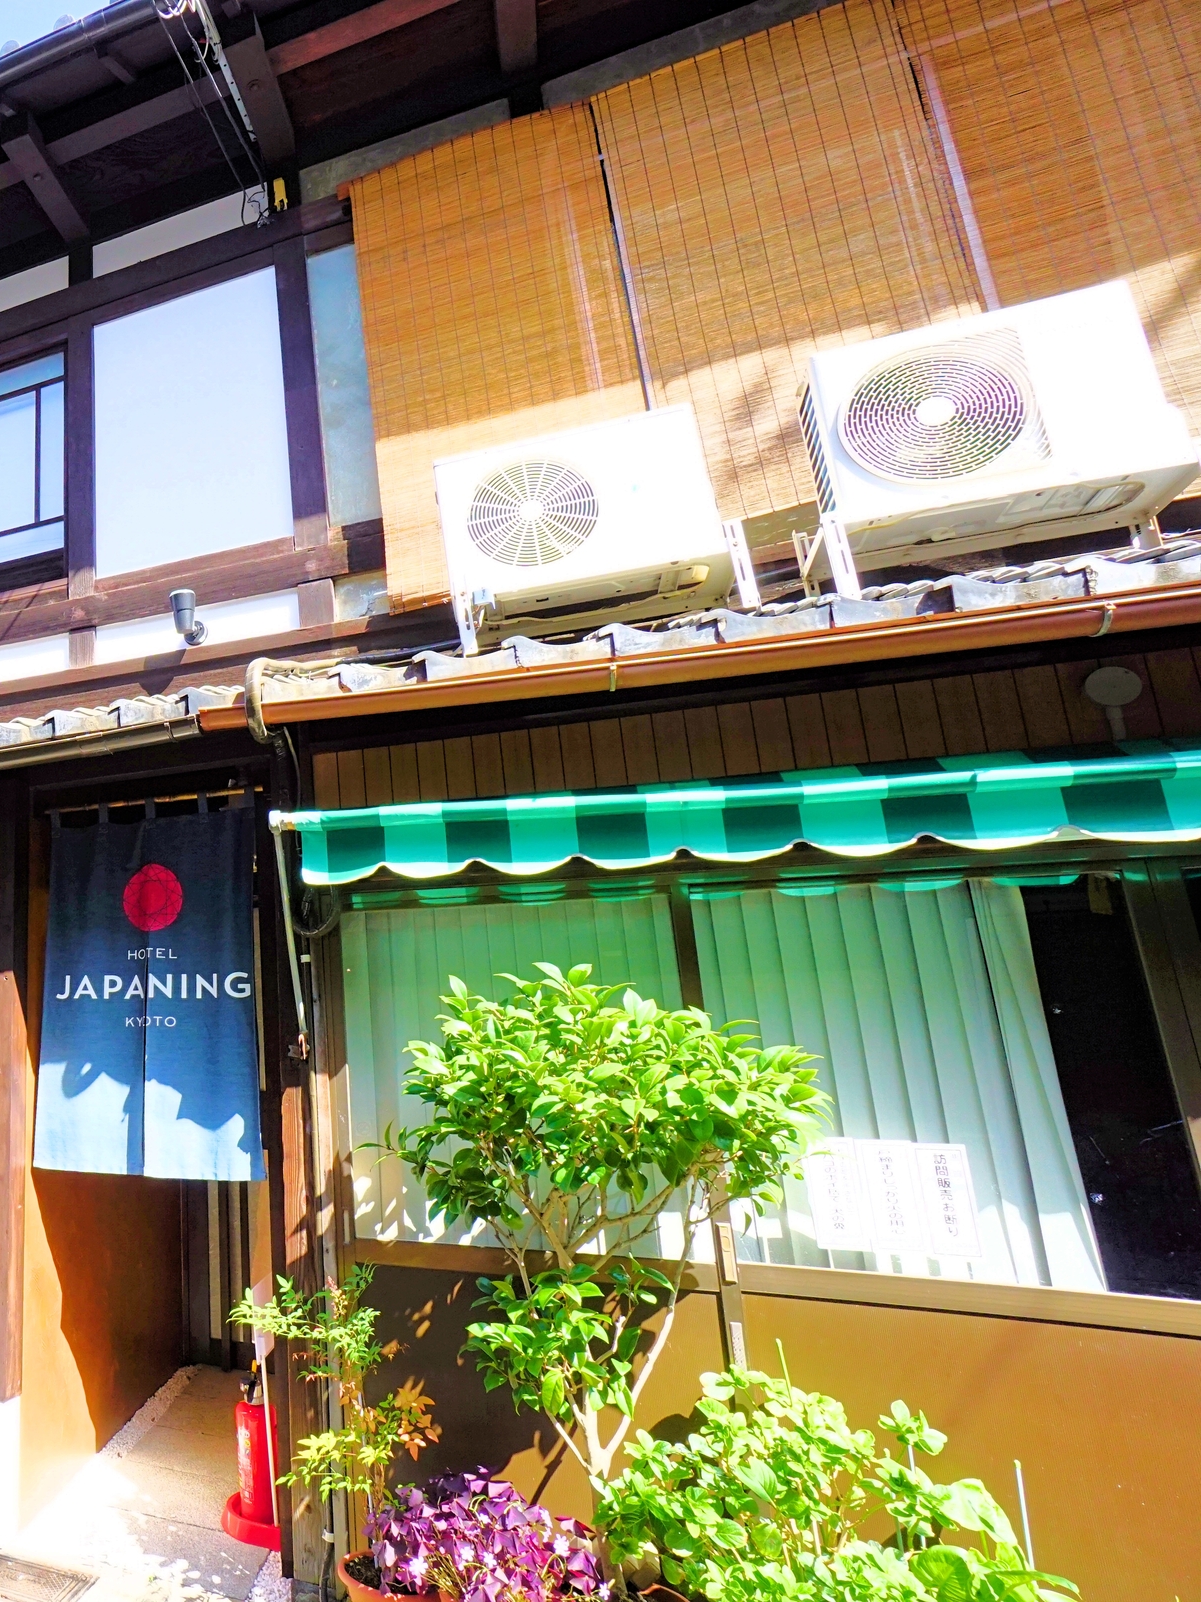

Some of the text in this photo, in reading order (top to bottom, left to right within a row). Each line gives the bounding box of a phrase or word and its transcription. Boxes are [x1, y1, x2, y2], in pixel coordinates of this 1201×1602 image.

[127, 947, 178, 960] HOTEL
[55, 972, 252, 1000] JAPANING
[125, 1016, 177, 1028] KYOTO
[933, 1153, 959, 1237] 訪問販売お断り
